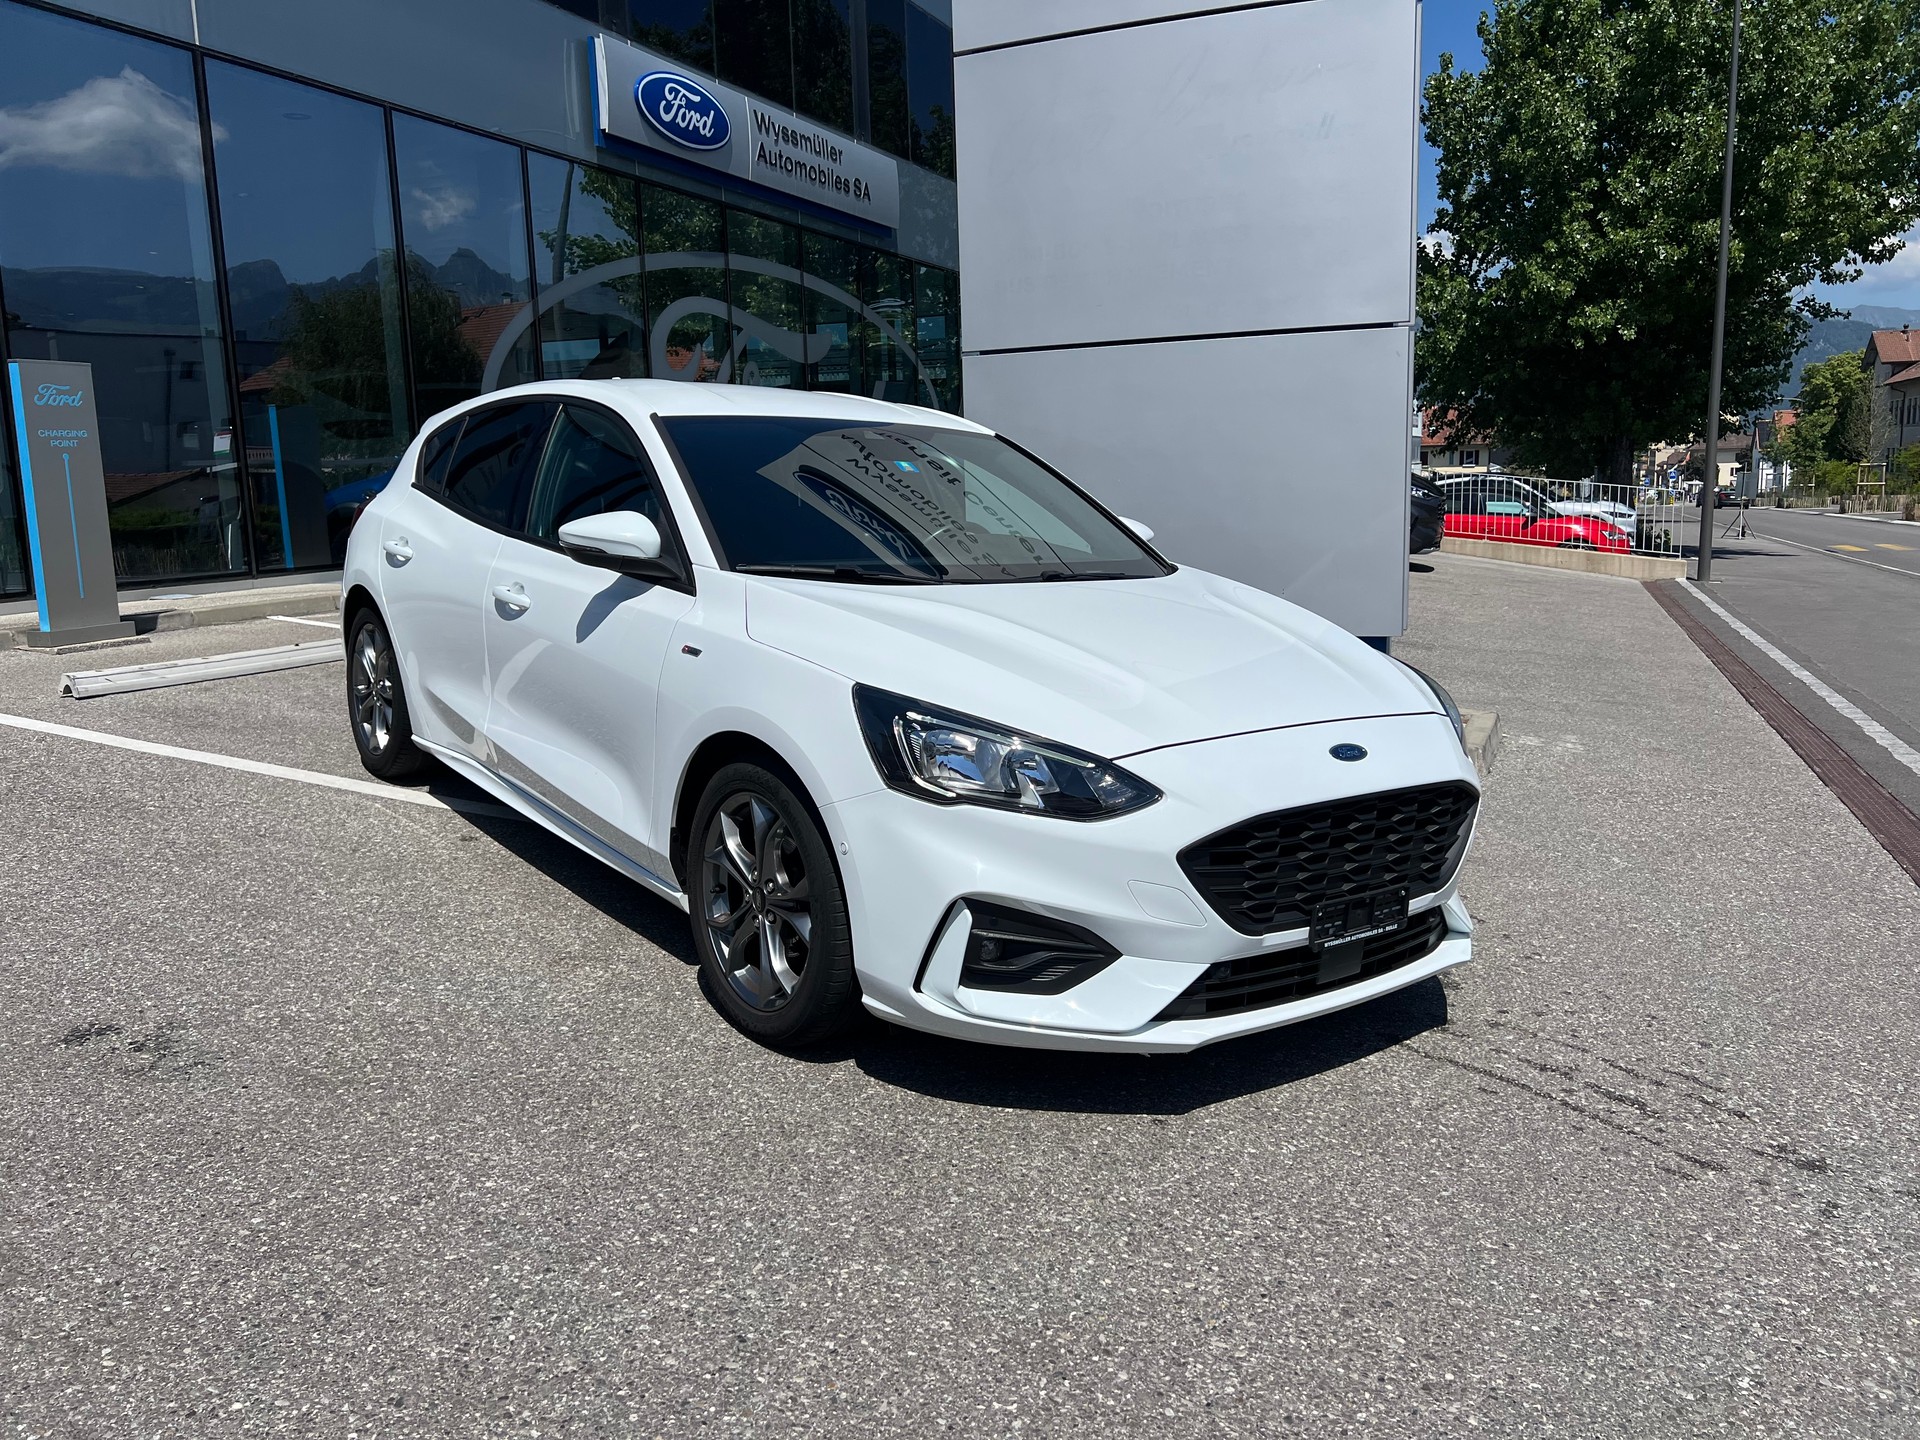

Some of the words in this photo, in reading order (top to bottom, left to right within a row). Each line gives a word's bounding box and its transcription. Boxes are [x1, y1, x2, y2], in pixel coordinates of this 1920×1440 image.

[659, 82, 715, 138] Ford
[753, 109, 843, 166] Wyssmüller
[756, 141, 851, 194] Automobiles
[853, 176, 872, 202] SA
[34, 383, 83, 407] Ford
[38, 429, 88, 438] CHARGING
[50, 440, 79, 448] POINT
